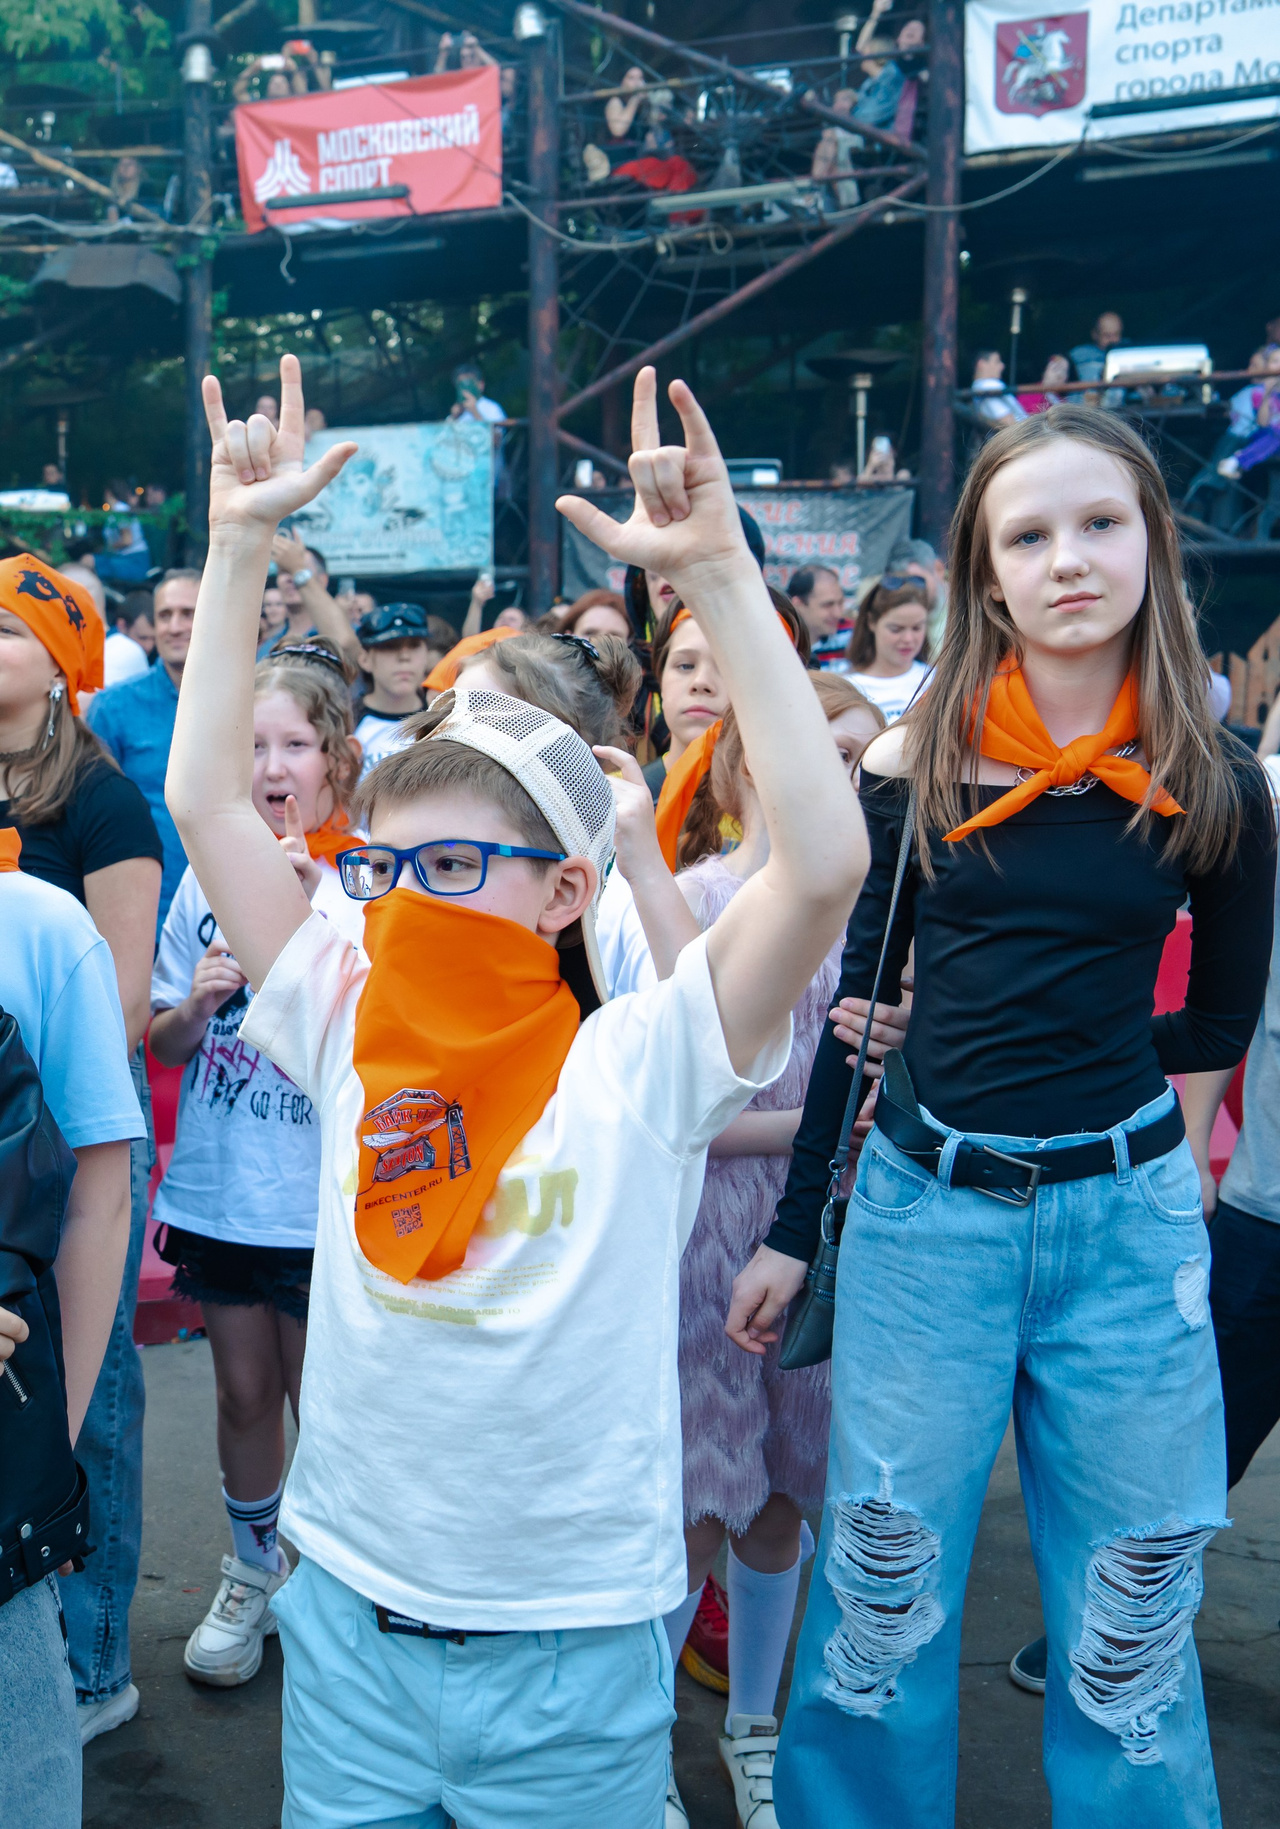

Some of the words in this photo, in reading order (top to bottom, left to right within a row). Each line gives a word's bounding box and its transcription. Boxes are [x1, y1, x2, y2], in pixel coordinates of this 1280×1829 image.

[1115, 0, 1280, 33] Департам
[1115, 33, 1223, 65] спорта
[1115, 69, 1223, 101] города
[317, 104, 481, 165] МОСКОВСКИЙ
[319, 157, 393, 193] СПОРТ
[279, 1091, 312, 1125] FOR
[364, 1177, 443, 1210] BIKECENTER.RU
[438, 1304, 504, 1315] BOUNDARIES
